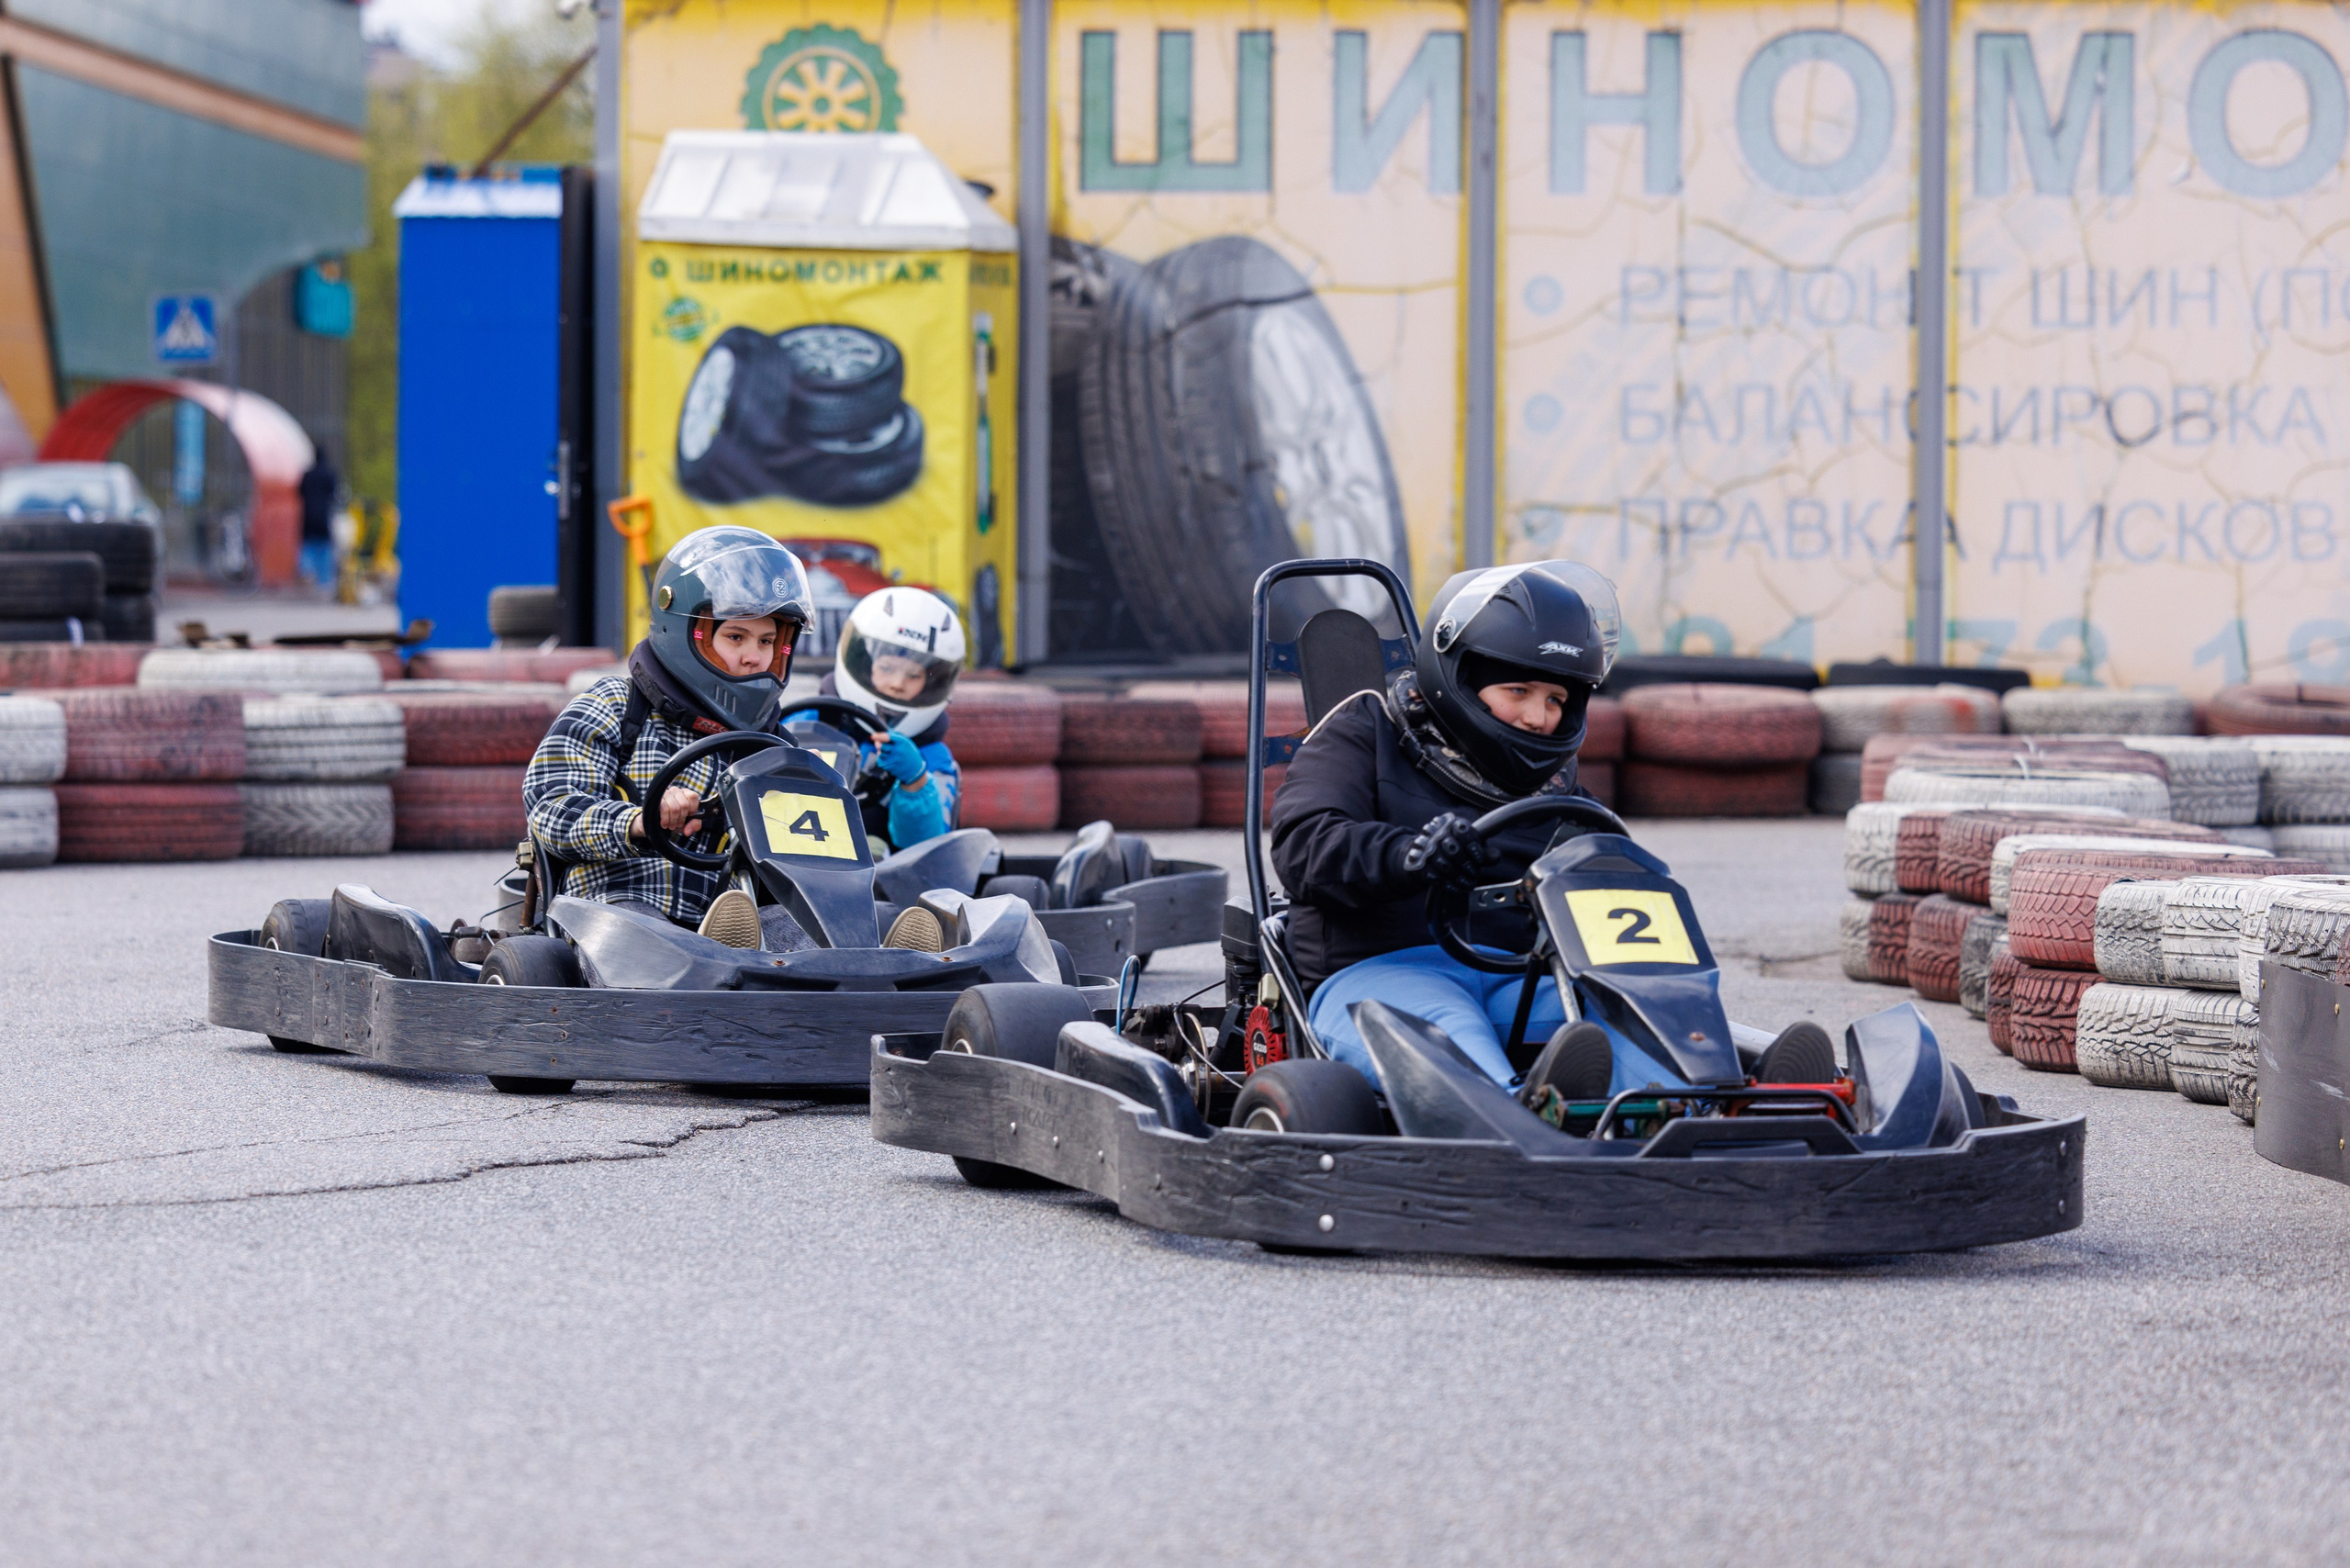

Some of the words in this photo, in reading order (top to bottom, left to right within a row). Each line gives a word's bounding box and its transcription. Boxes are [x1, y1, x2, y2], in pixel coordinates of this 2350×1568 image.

[686, 258, 943, 284] ШИНОМОНТАЖ
[2030, 266, 2220, 330] ШИН
[1619, 382, 2329, 448] БАЛАНСИРОВКА
[1618, 498, 1967, 562] ПРАВКА
[1990, 498, 2340, 576] ДИСКОВ
[789, 810, 830, 842] 4
[1607, 908, 1661, 944] 2
